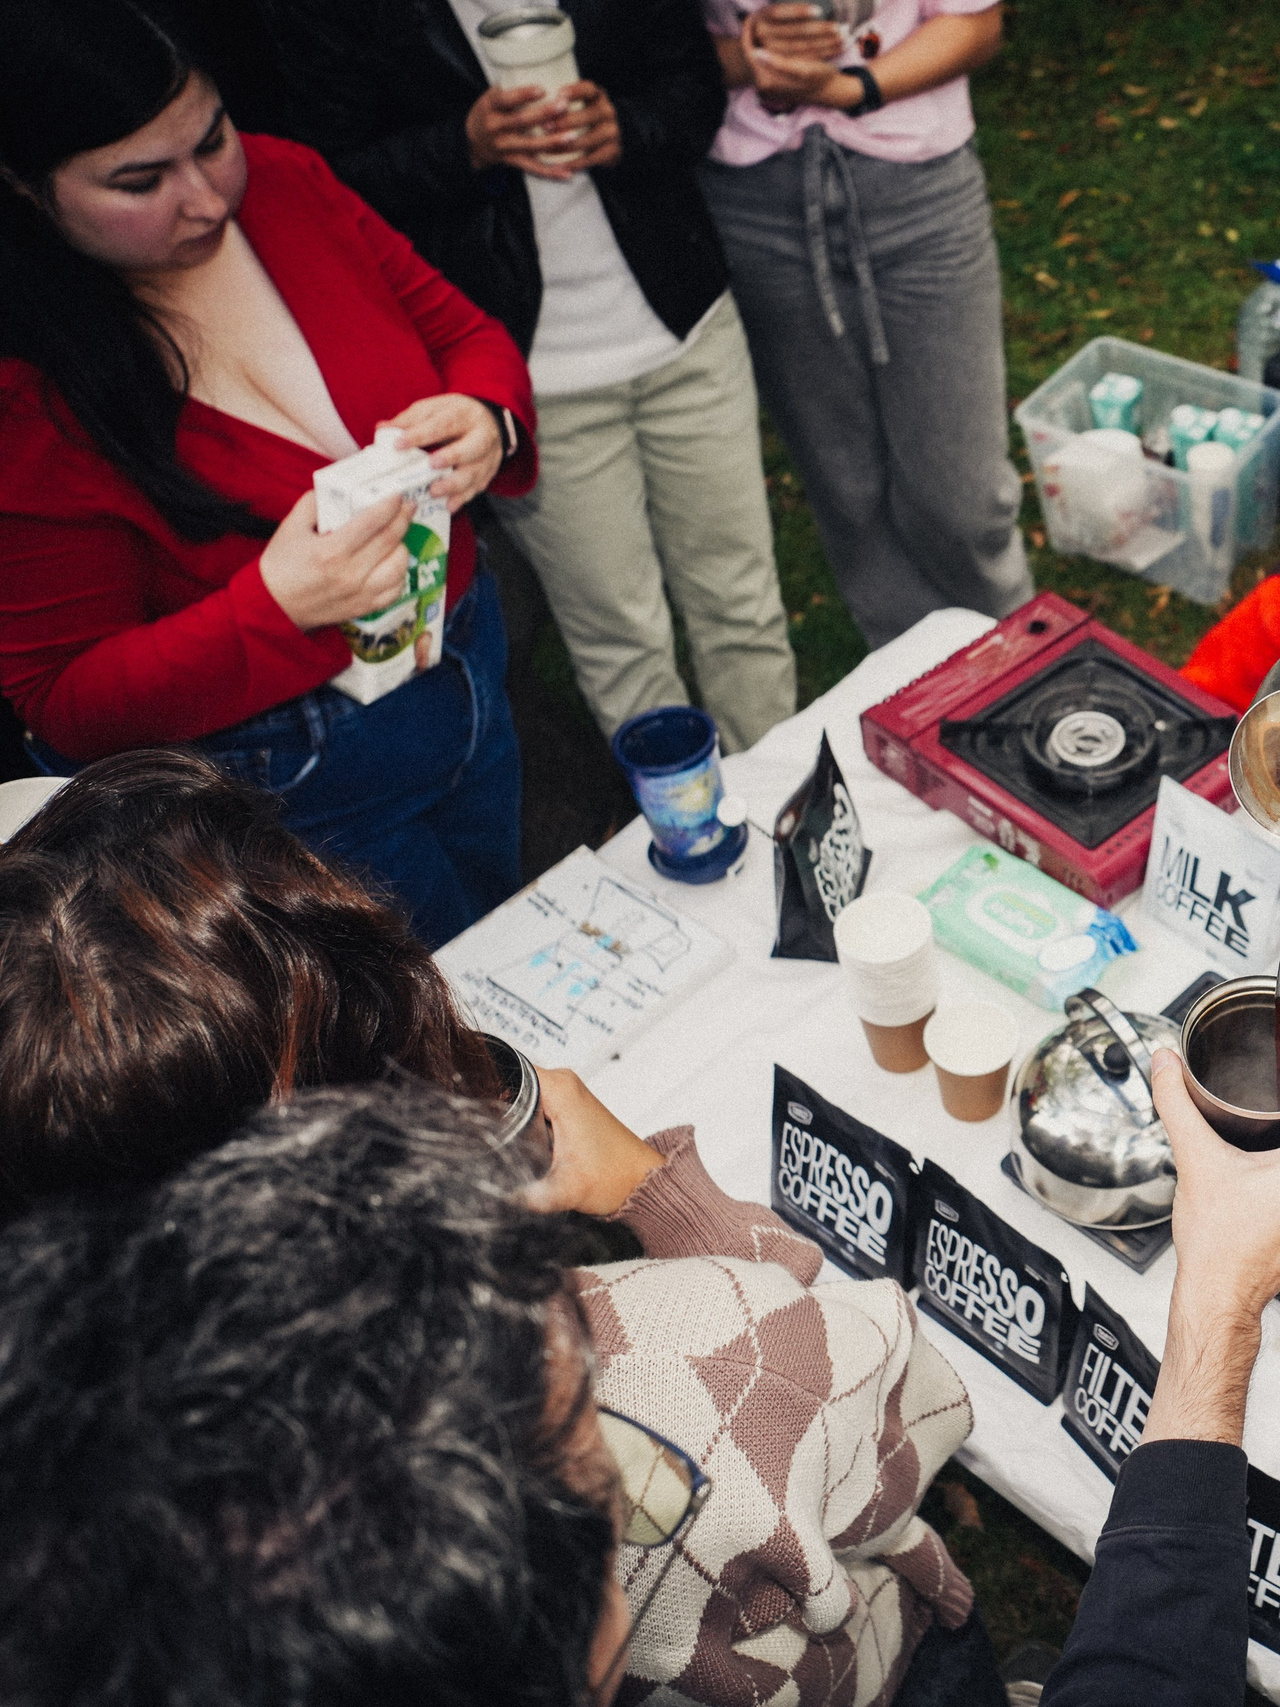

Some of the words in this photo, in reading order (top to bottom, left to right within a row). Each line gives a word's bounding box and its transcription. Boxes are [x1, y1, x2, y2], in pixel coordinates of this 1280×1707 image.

[1156, 877, 1250, 958] COFFEE
[1159, 837, 1256, 932] MILK
[778, 1168, 888, 1265] COFFEE
[781, 1121, 893, 1235] ESPRESSO
[924, 1265, 1042, 1364] COFFEE
[926, 1219, 1046, 1337] ESPRESSO
[1073, 1386, 1139, 1456] COFF
[1079, 1342, 1153, 1443] FILTE
